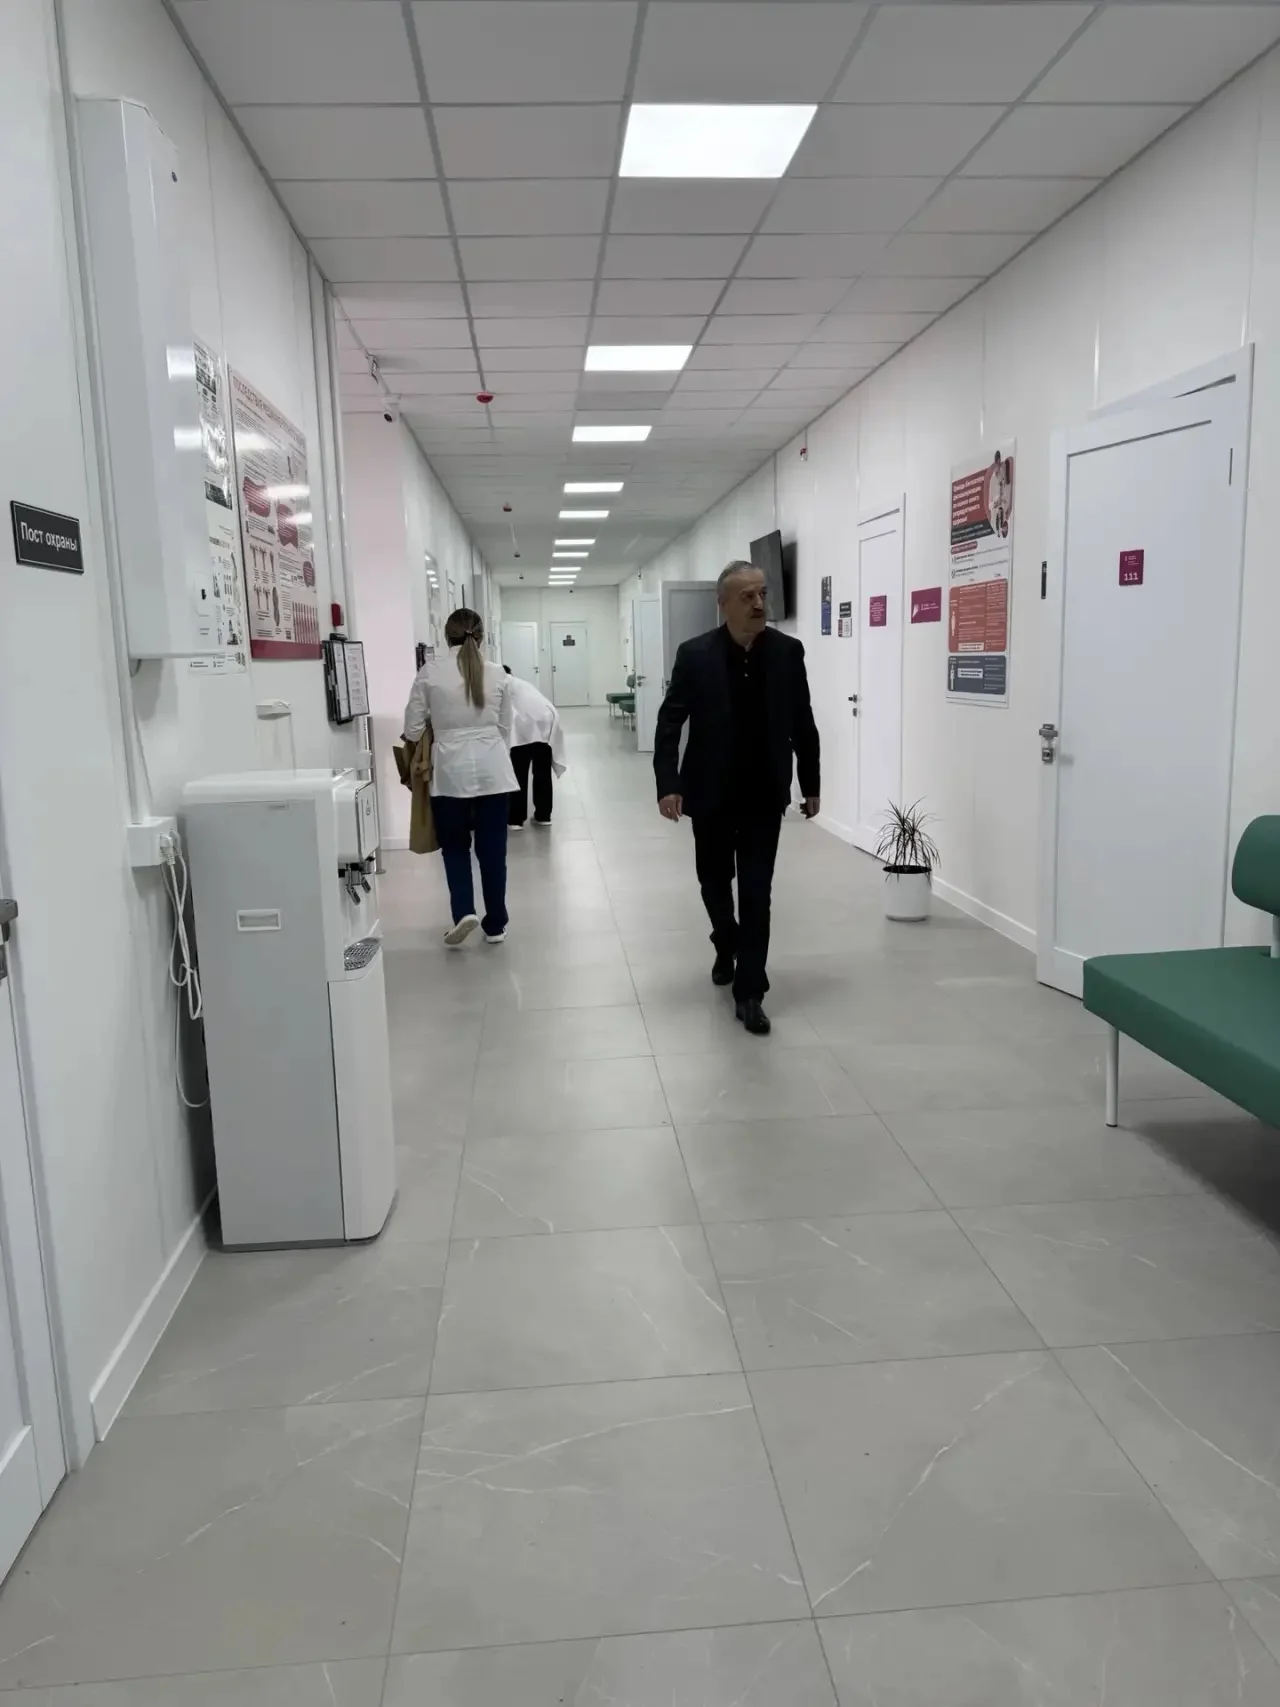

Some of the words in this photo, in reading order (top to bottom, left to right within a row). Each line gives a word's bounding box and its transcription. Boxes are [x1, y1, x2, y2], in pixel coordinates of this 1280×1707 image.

[20, 521, 44, 544] Пост
[45, 532, 78, 552] охраны
[1124, 572, 1138, 581] 111
